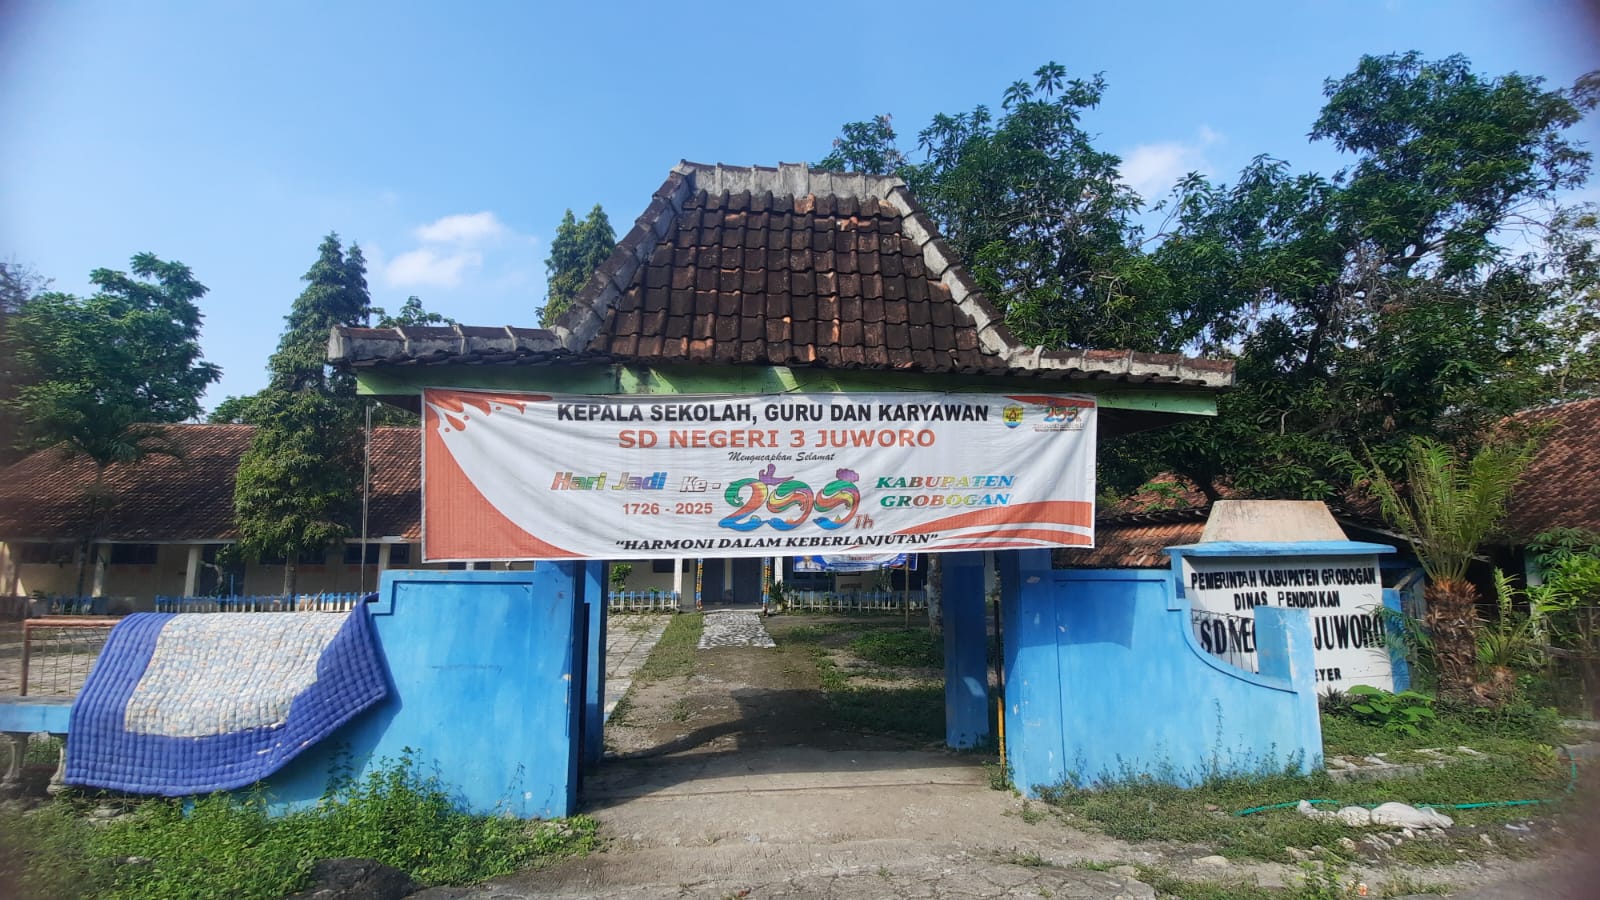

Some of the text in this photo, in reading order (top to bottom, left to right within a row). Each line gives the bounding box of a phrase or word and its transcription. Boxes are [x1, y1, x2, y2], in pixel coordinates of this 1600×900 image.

[558, 404, 988, 424] KEPALA SEKOLAH, GURU DAN KARYAWAN
[619, 429, 935, 448] SD NEGERI 3 JUWORO
[796, 451, 835, 462] Selamat
[551, 472, 607, 490] Hari
[612, 472, 668, 490] Jadi
[875, 475, 1016, 489] KABUPATEN
[623, 503, 660, 515] 1726
[675, 502, 713, 515] 2025
[880, 493, 1011, 507] GROBOGAN
[718, 537, 781, 549] DALAM
[1191, 567, 1376, 589] PEMERINTAH KABUPATEN GROBOGAN
[1234, 590, 1340, 611] DINAS PENDIDIKAN
[1314, 614, 1385, 650] JUWORO
